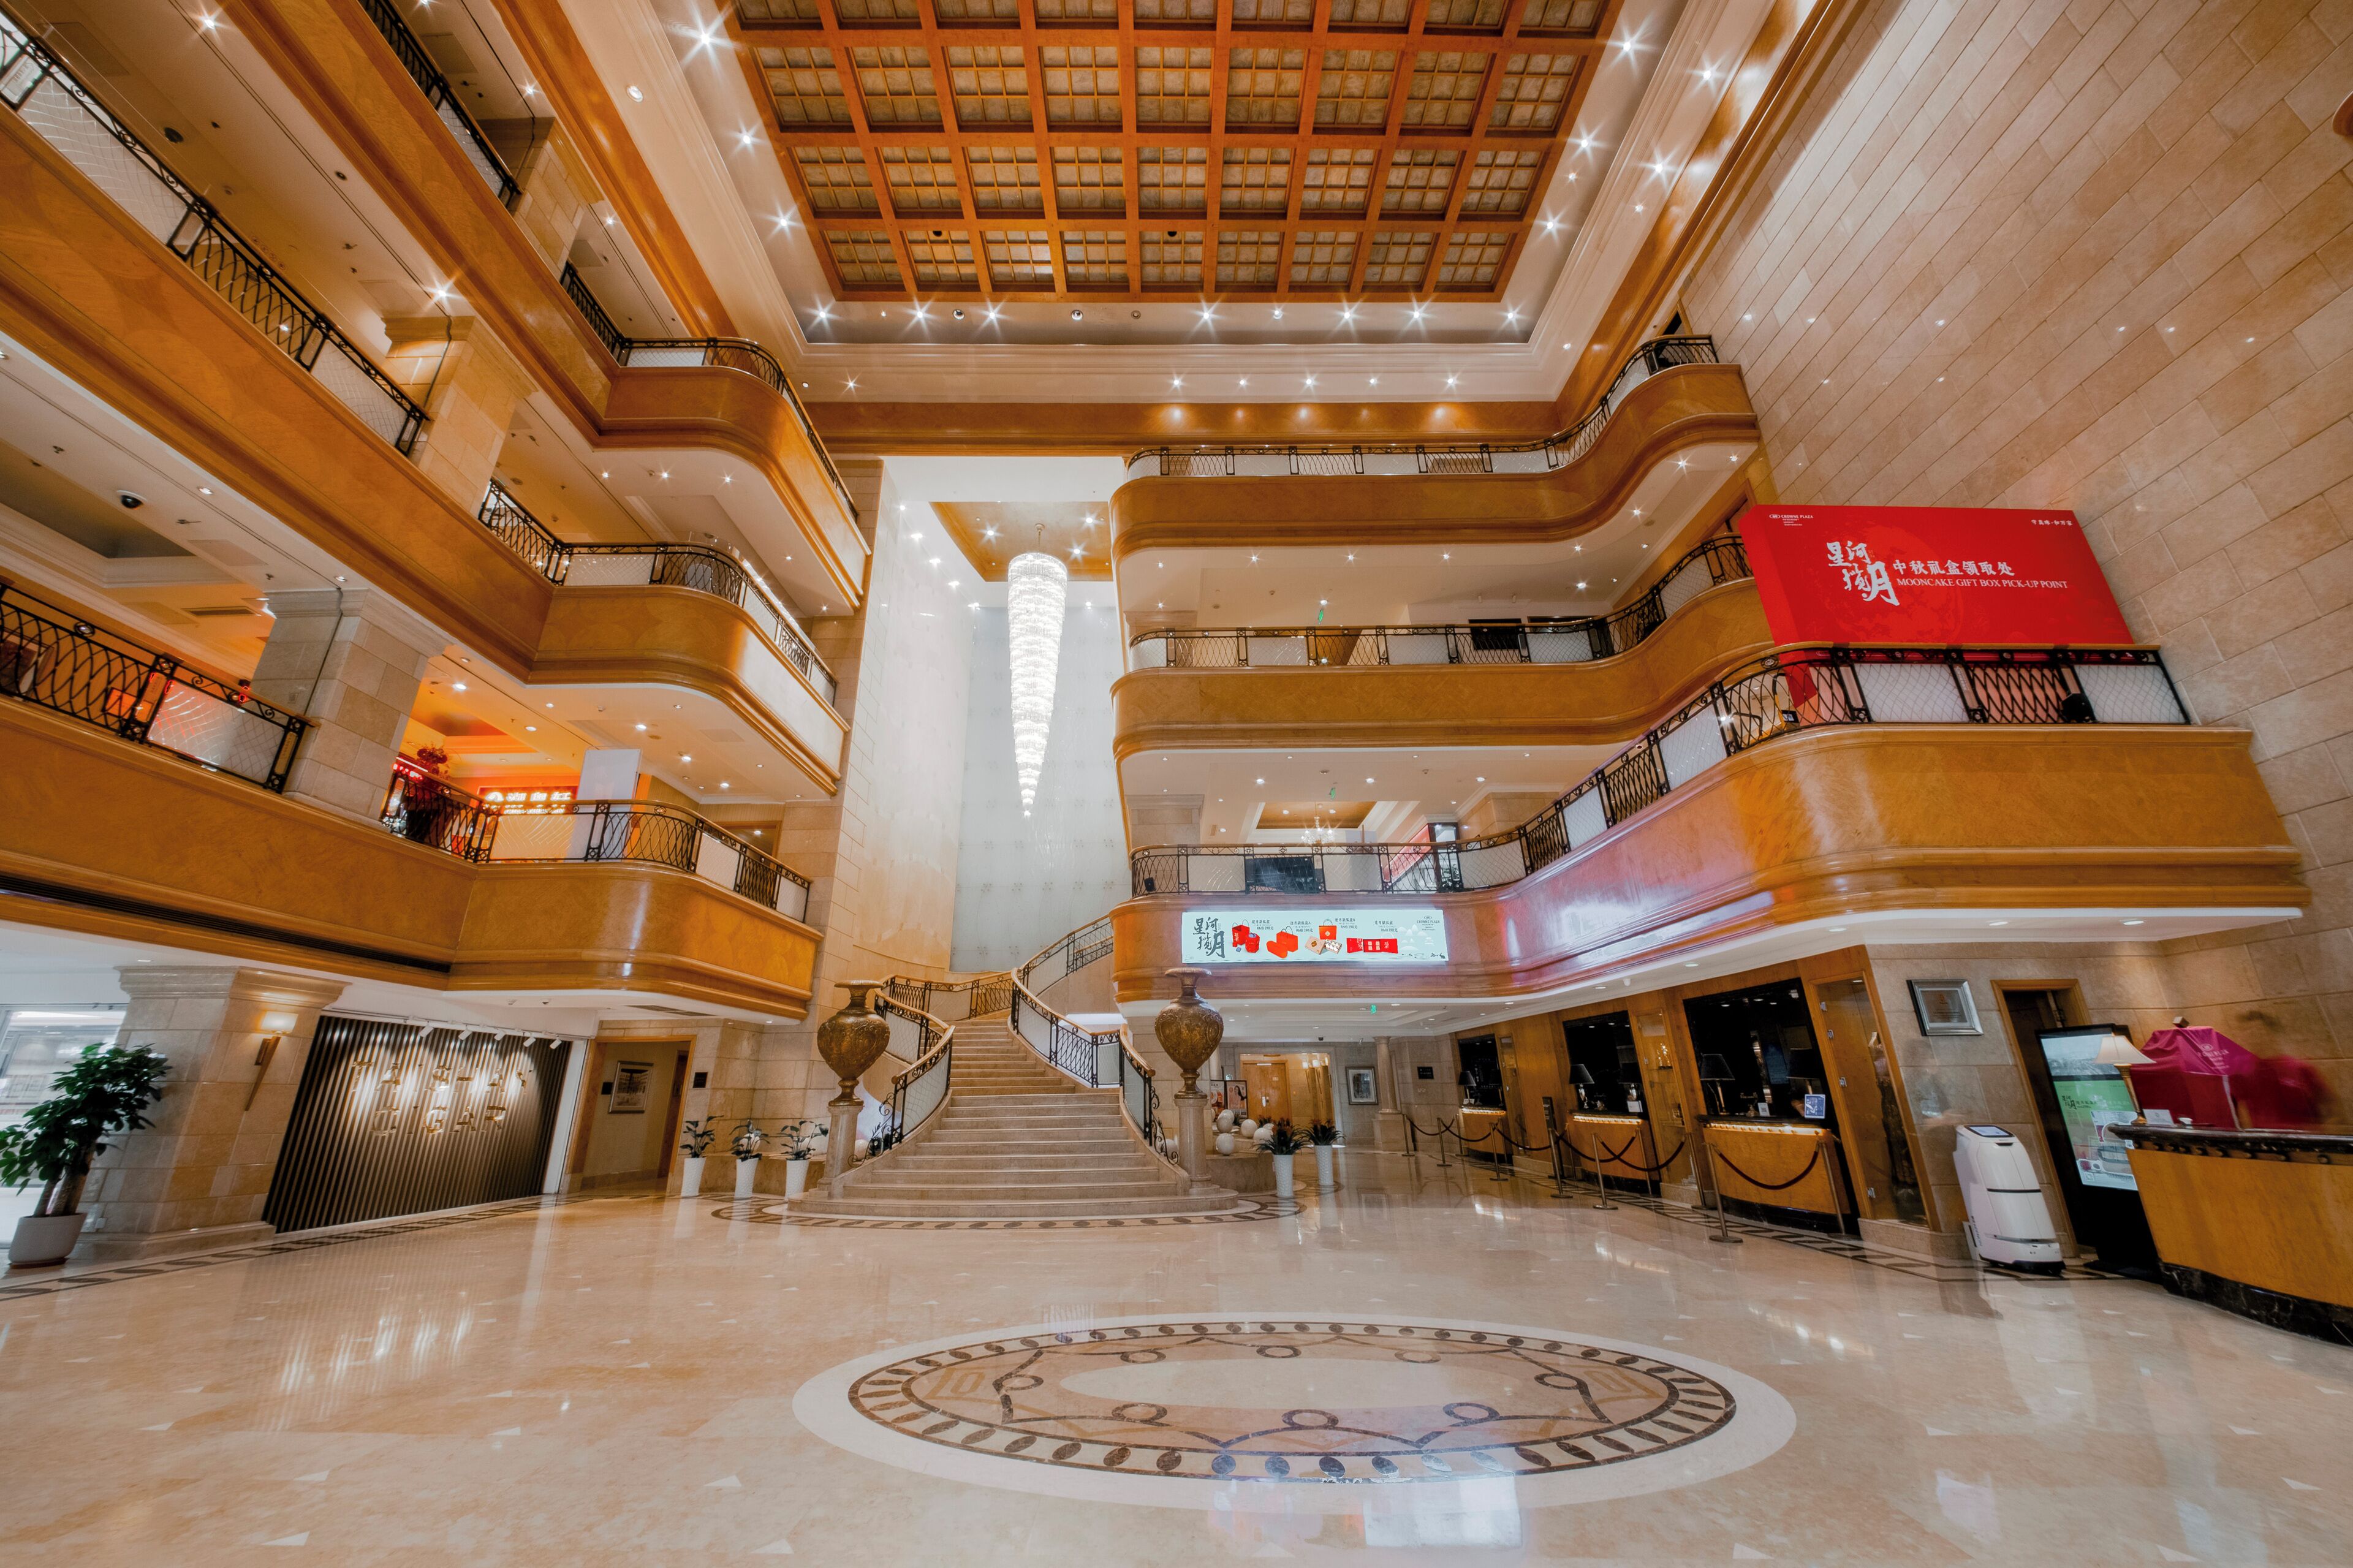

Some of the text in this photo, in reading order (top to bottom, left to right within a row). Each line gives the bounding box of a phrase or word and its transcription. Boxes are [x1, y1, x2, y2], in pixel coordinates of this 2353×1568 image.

[1892, 559, 2015, 577] 中秋礼盒领取处
[1896, 578, 1955, 586] MOONCAKE
[1979, 579, 2001, 588] BOX
[2001, 580, 2039, 588] PICK-UP
[2040, 580, 2068, 589] POINT
